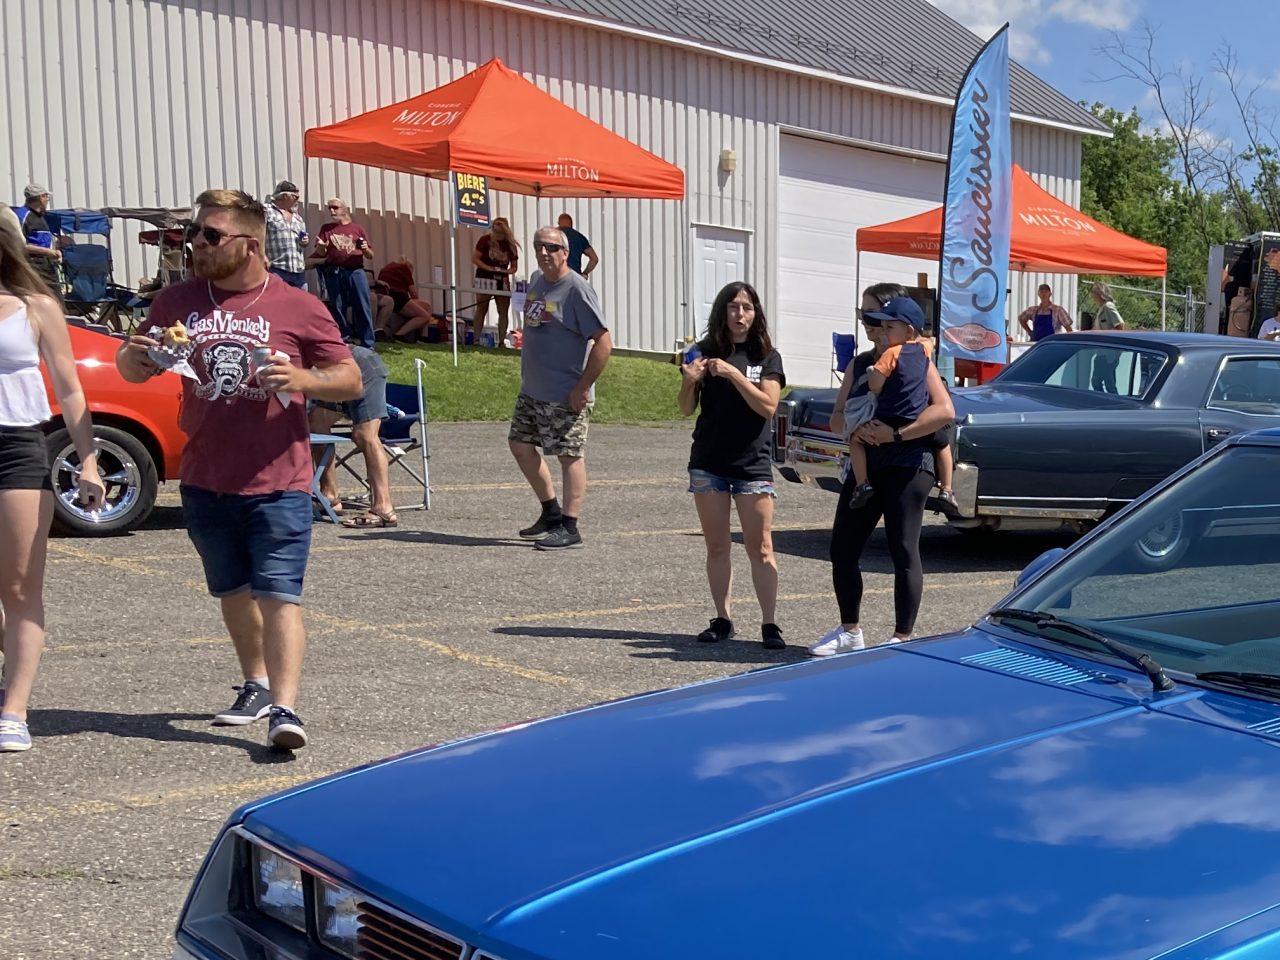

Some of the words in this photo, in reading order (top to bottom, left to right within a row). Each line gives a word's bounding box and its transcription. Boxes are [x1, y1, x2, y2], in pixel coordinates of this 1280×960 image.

[392, 109, 462, 127] MILTON
[546, 163, 599, 182] MILTON
[950, 77, 999, 313] Saucissier
[1018, 212, 1097, 233] MILTON
